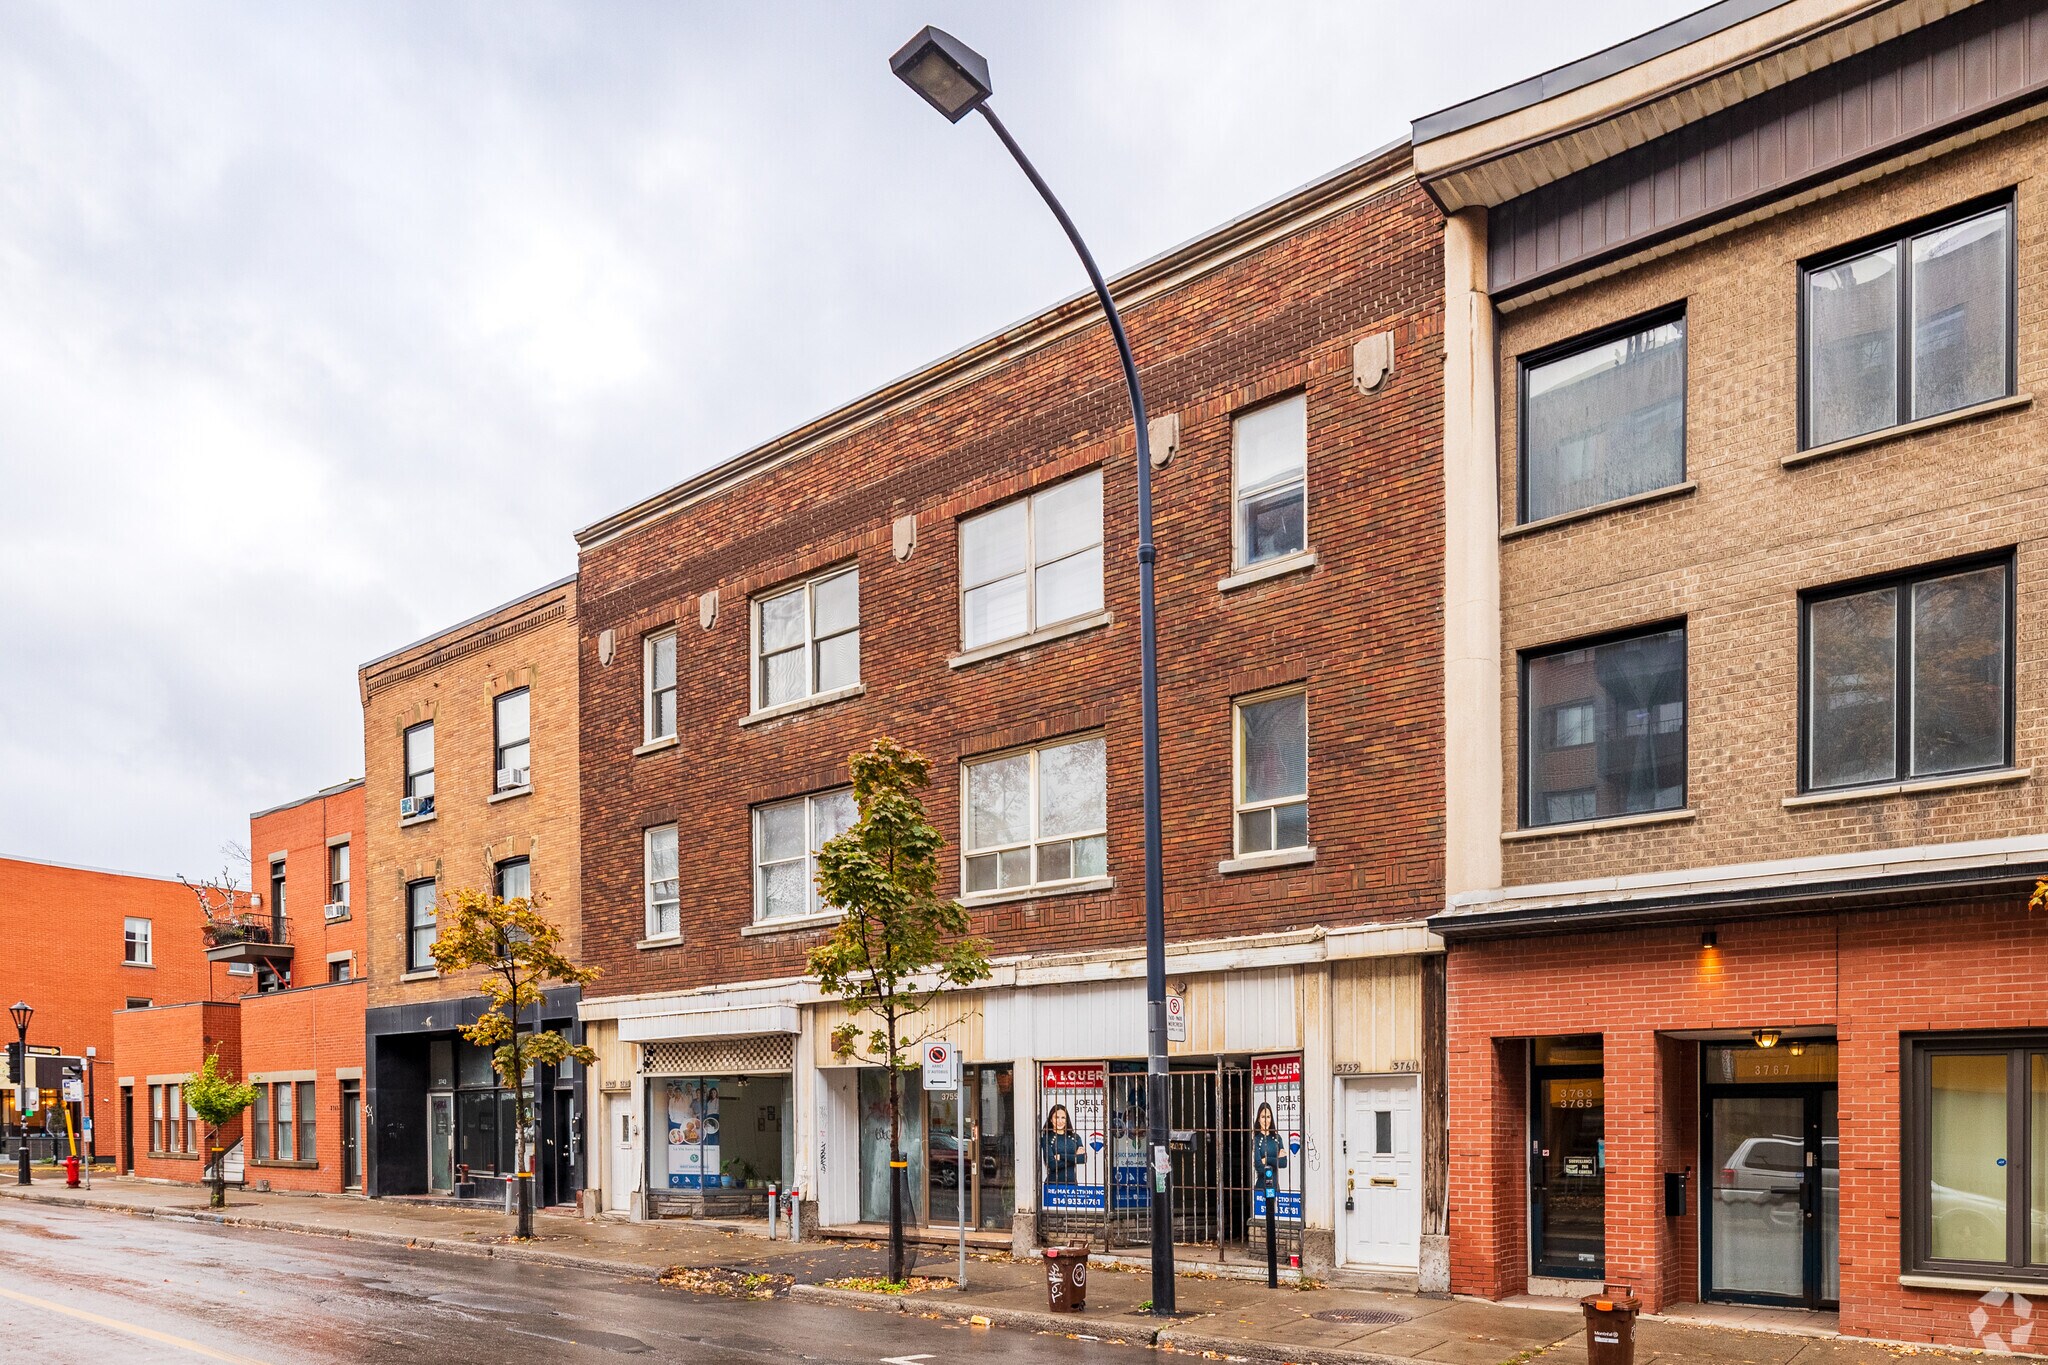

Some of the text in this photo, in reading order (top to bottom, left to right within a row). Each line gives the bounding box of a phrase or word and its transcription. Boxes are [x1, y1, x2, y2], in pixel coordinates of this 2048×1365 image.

[1254, 1062, 1300, 1076] À LOUER
[1336, 1063, 1359, 1072] 3759
[1393, 1062, 1415, 1070] 3761
[1755, 1065, 1790, 1075] 3767
[1047, 1068, 1104, 1081] À LOUER
[1560, 1089, 1593, 1098] 3763
[1560, 1099, 1593, 1108] 3765
